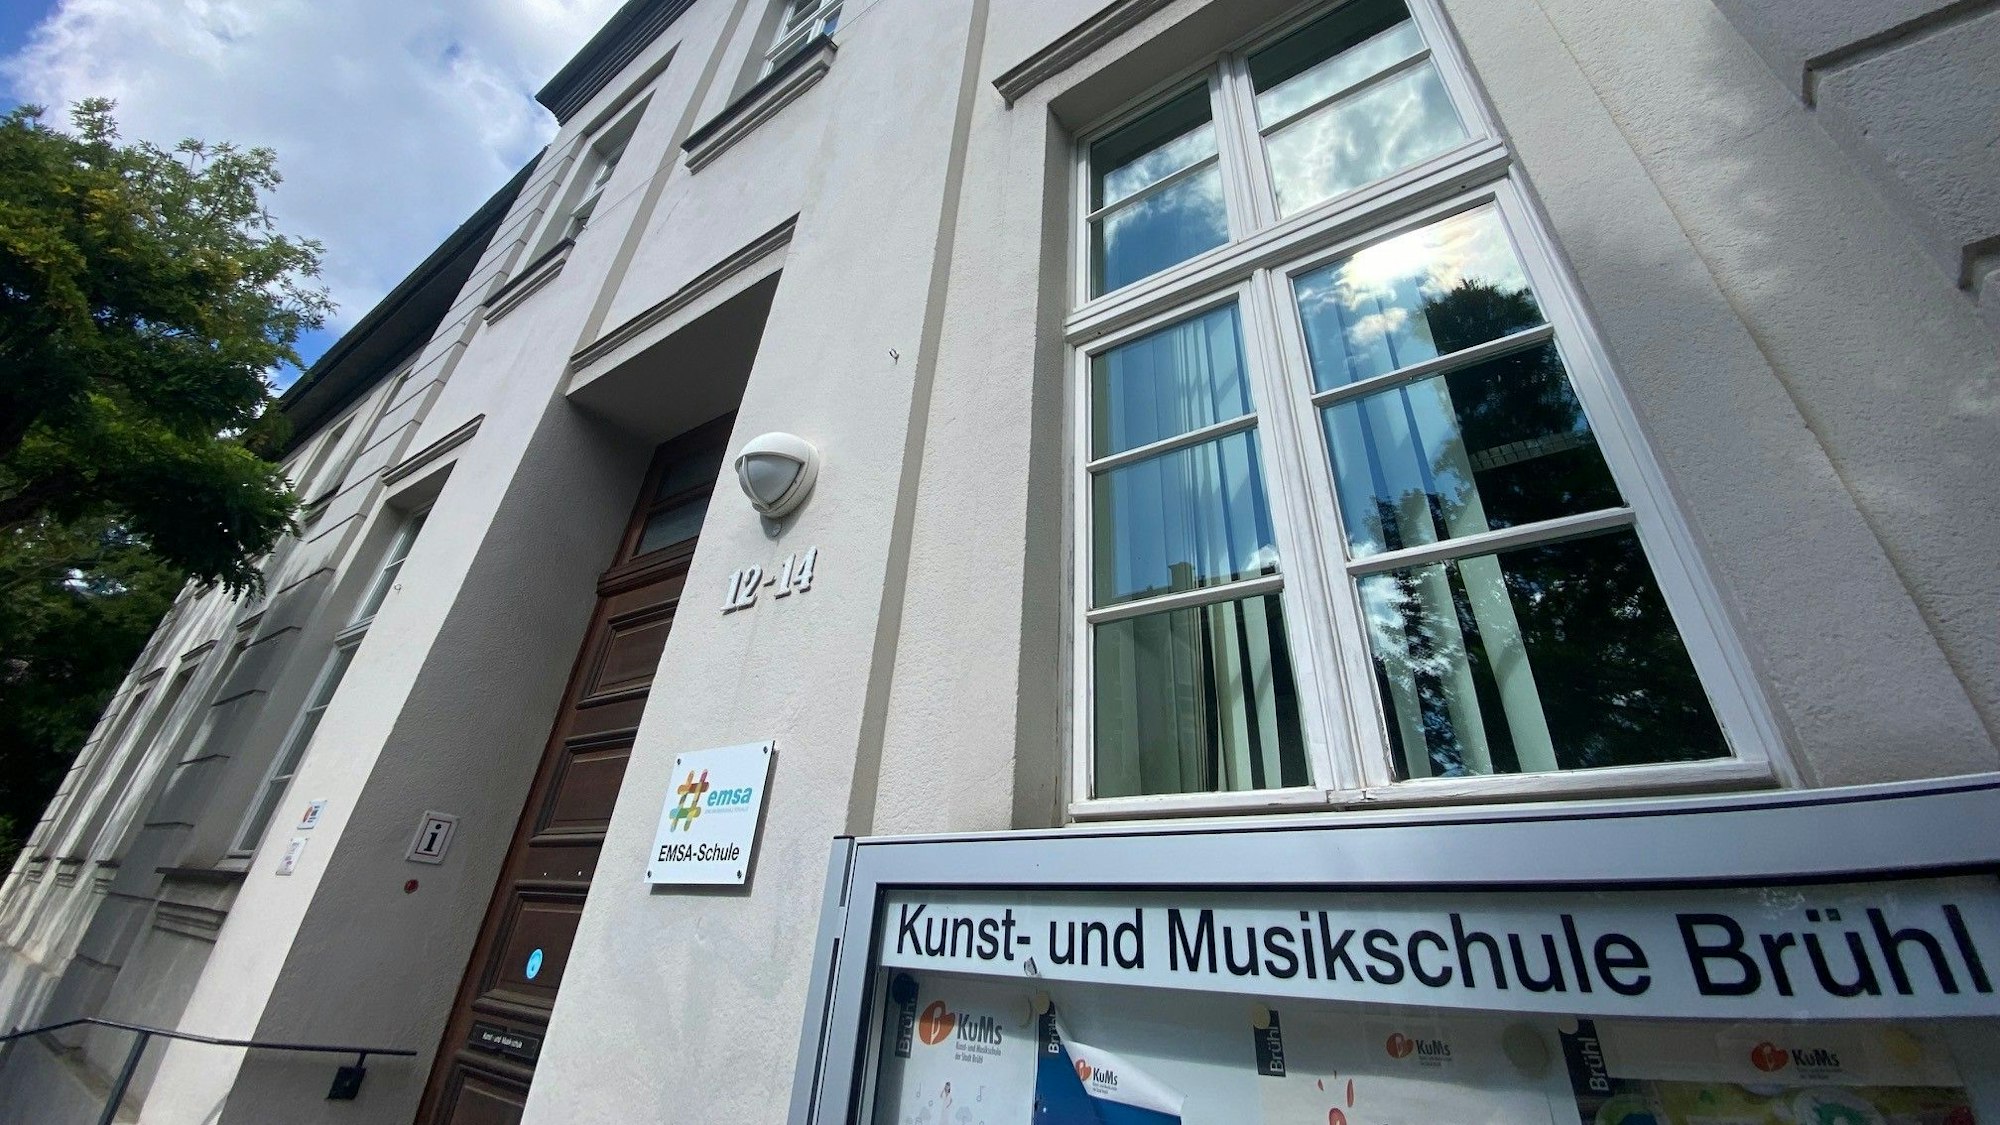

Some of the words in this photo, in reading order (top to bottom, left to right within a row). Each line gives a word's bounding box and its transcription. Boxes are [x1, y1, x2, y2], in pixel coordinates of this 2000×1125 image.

[720, 545, 817, 614] 12-14
[707, 787, 753, 807] emsa
[657, 842, 740, 862] EMSA-Schule
[897, 903, 1031, 961] Kunst-
[1050, 907, 1145, 970] und
[1168, 908, 1652, 997] Musikschule
[1675, 903, 1994, 998] Brühl
[956, 1013, 1003, 1045] KuMs
[1266, 1026, 1284, 1073] Brühl
[1415, 1039, 1451, 1056] KuMs
[1791, 1048, 1840, 1067] KuMs
[1093, 1067, 1118, 1086] KuMs
[1577, 1037, 1610, 1091] Brühl
